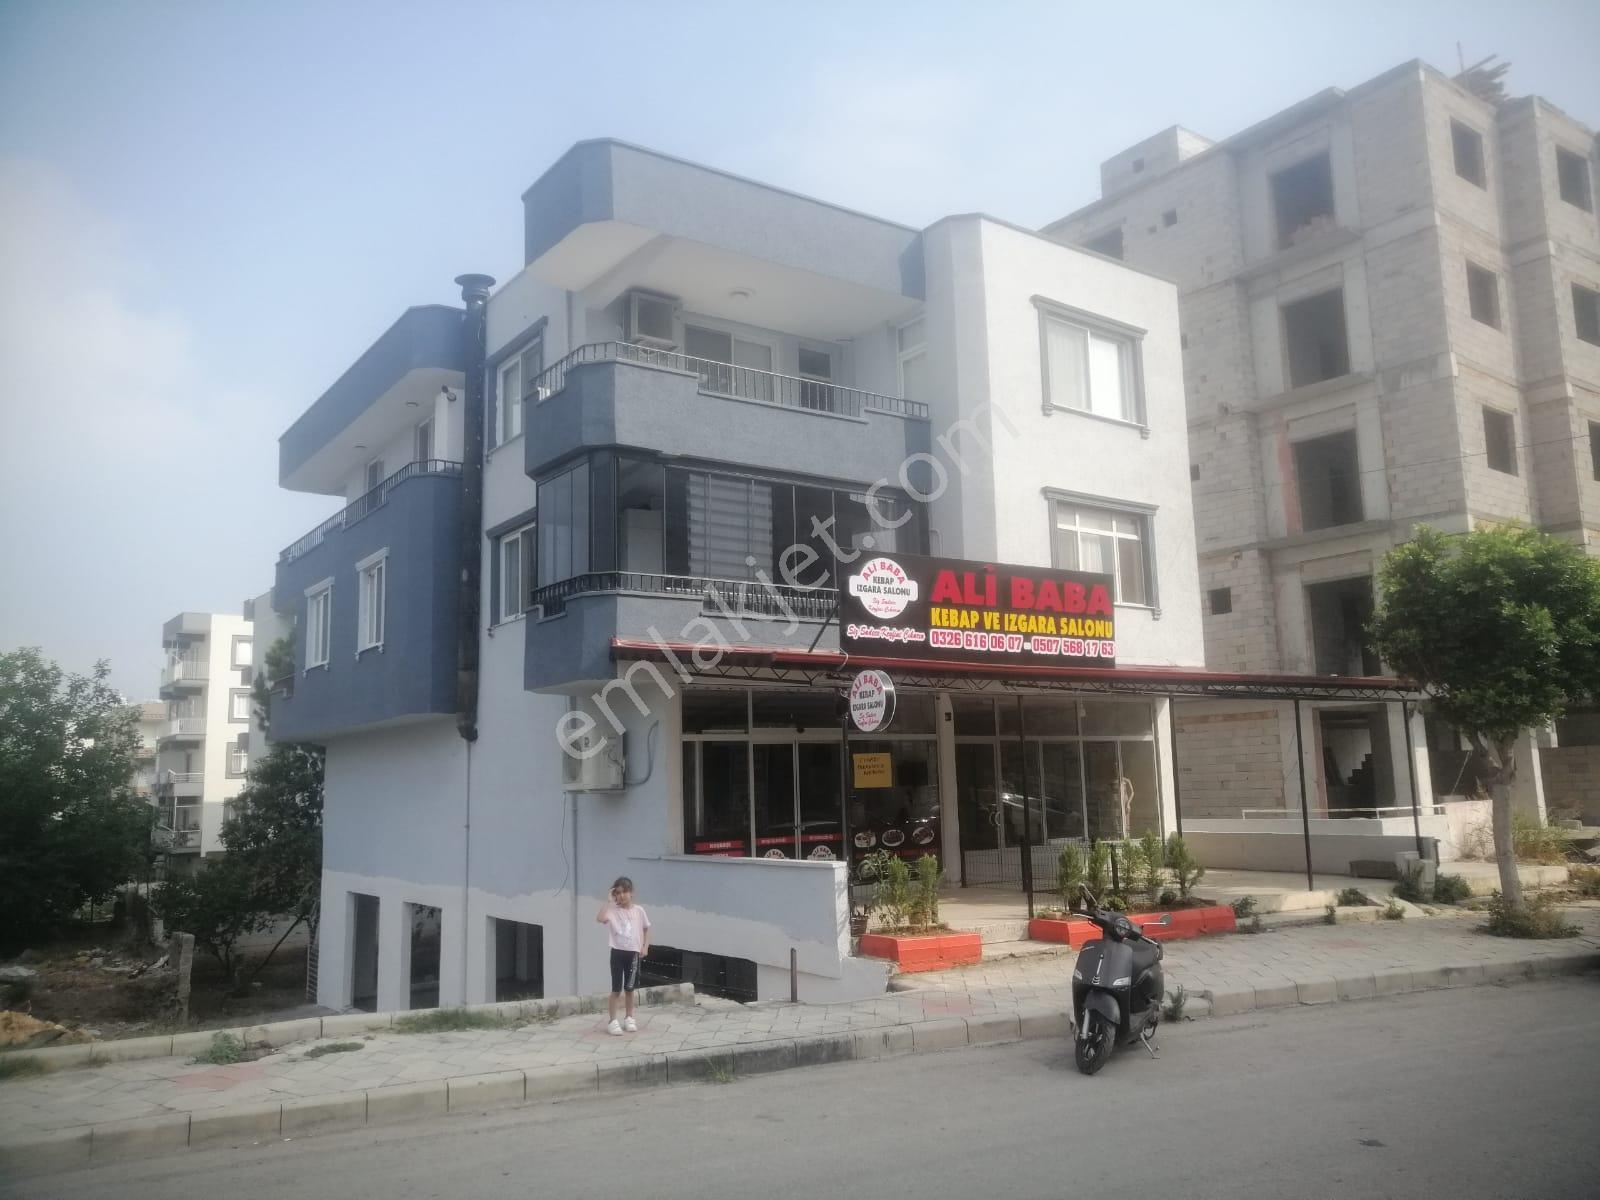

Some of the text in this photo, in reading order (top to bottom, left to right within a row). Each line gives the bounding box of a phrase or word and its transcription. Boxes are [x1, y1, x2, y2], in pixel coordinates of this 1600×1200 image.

[873, 576, 895, 585] KEBAP
[880, 562, 905, 584] BABA
[857, 584, 911, 596] IZGARA SALONU
[931, 564, 1113, 616] ALİ BABA
[931, 607, 1113, 638] KEBAP VE IZGARA SALONU
[930, 629, 962, 648] 0326
[964, 631, 988, 650] 616
[989, 633, 1006, 651] 06
[1007, 634, 1023, 652] 07
[1031, 636, 1060, 654] 0507
[1062, 638, 1084, 656] 568
[1085, 640, 1099, 657] 17
[1100, 641, 1115, 657] 63
[864, 675, 883, 695] BABA
